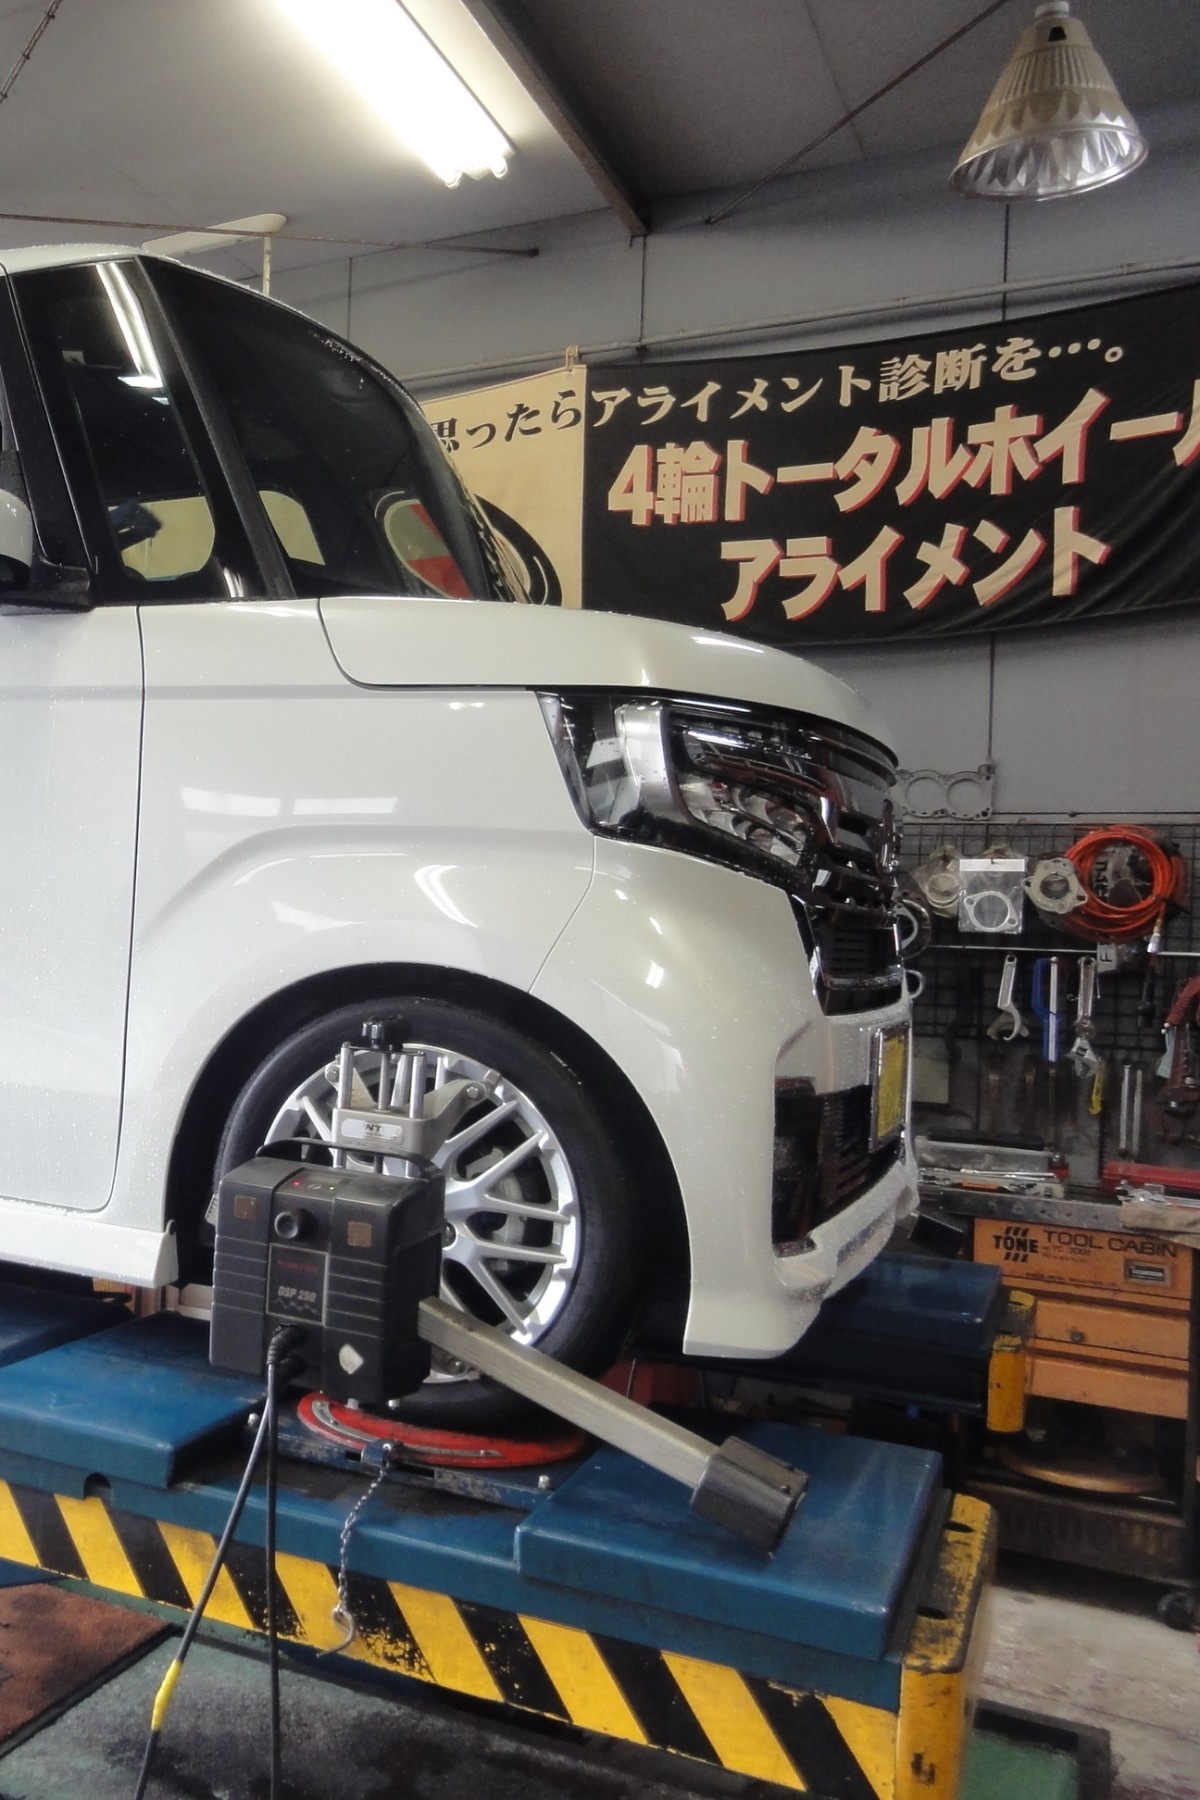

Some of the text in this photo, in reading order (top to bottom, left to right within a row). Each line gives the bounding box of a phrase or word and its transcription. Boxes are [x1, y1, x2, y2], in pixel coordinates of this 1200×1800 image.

[720, 506, 1111, 621] アライメント
[992, 1234, 1039, 1254] TONE
[1042, 1229, 1104, 1250] TOOL
[1107, 1237, 1178, 1258] CABIN
